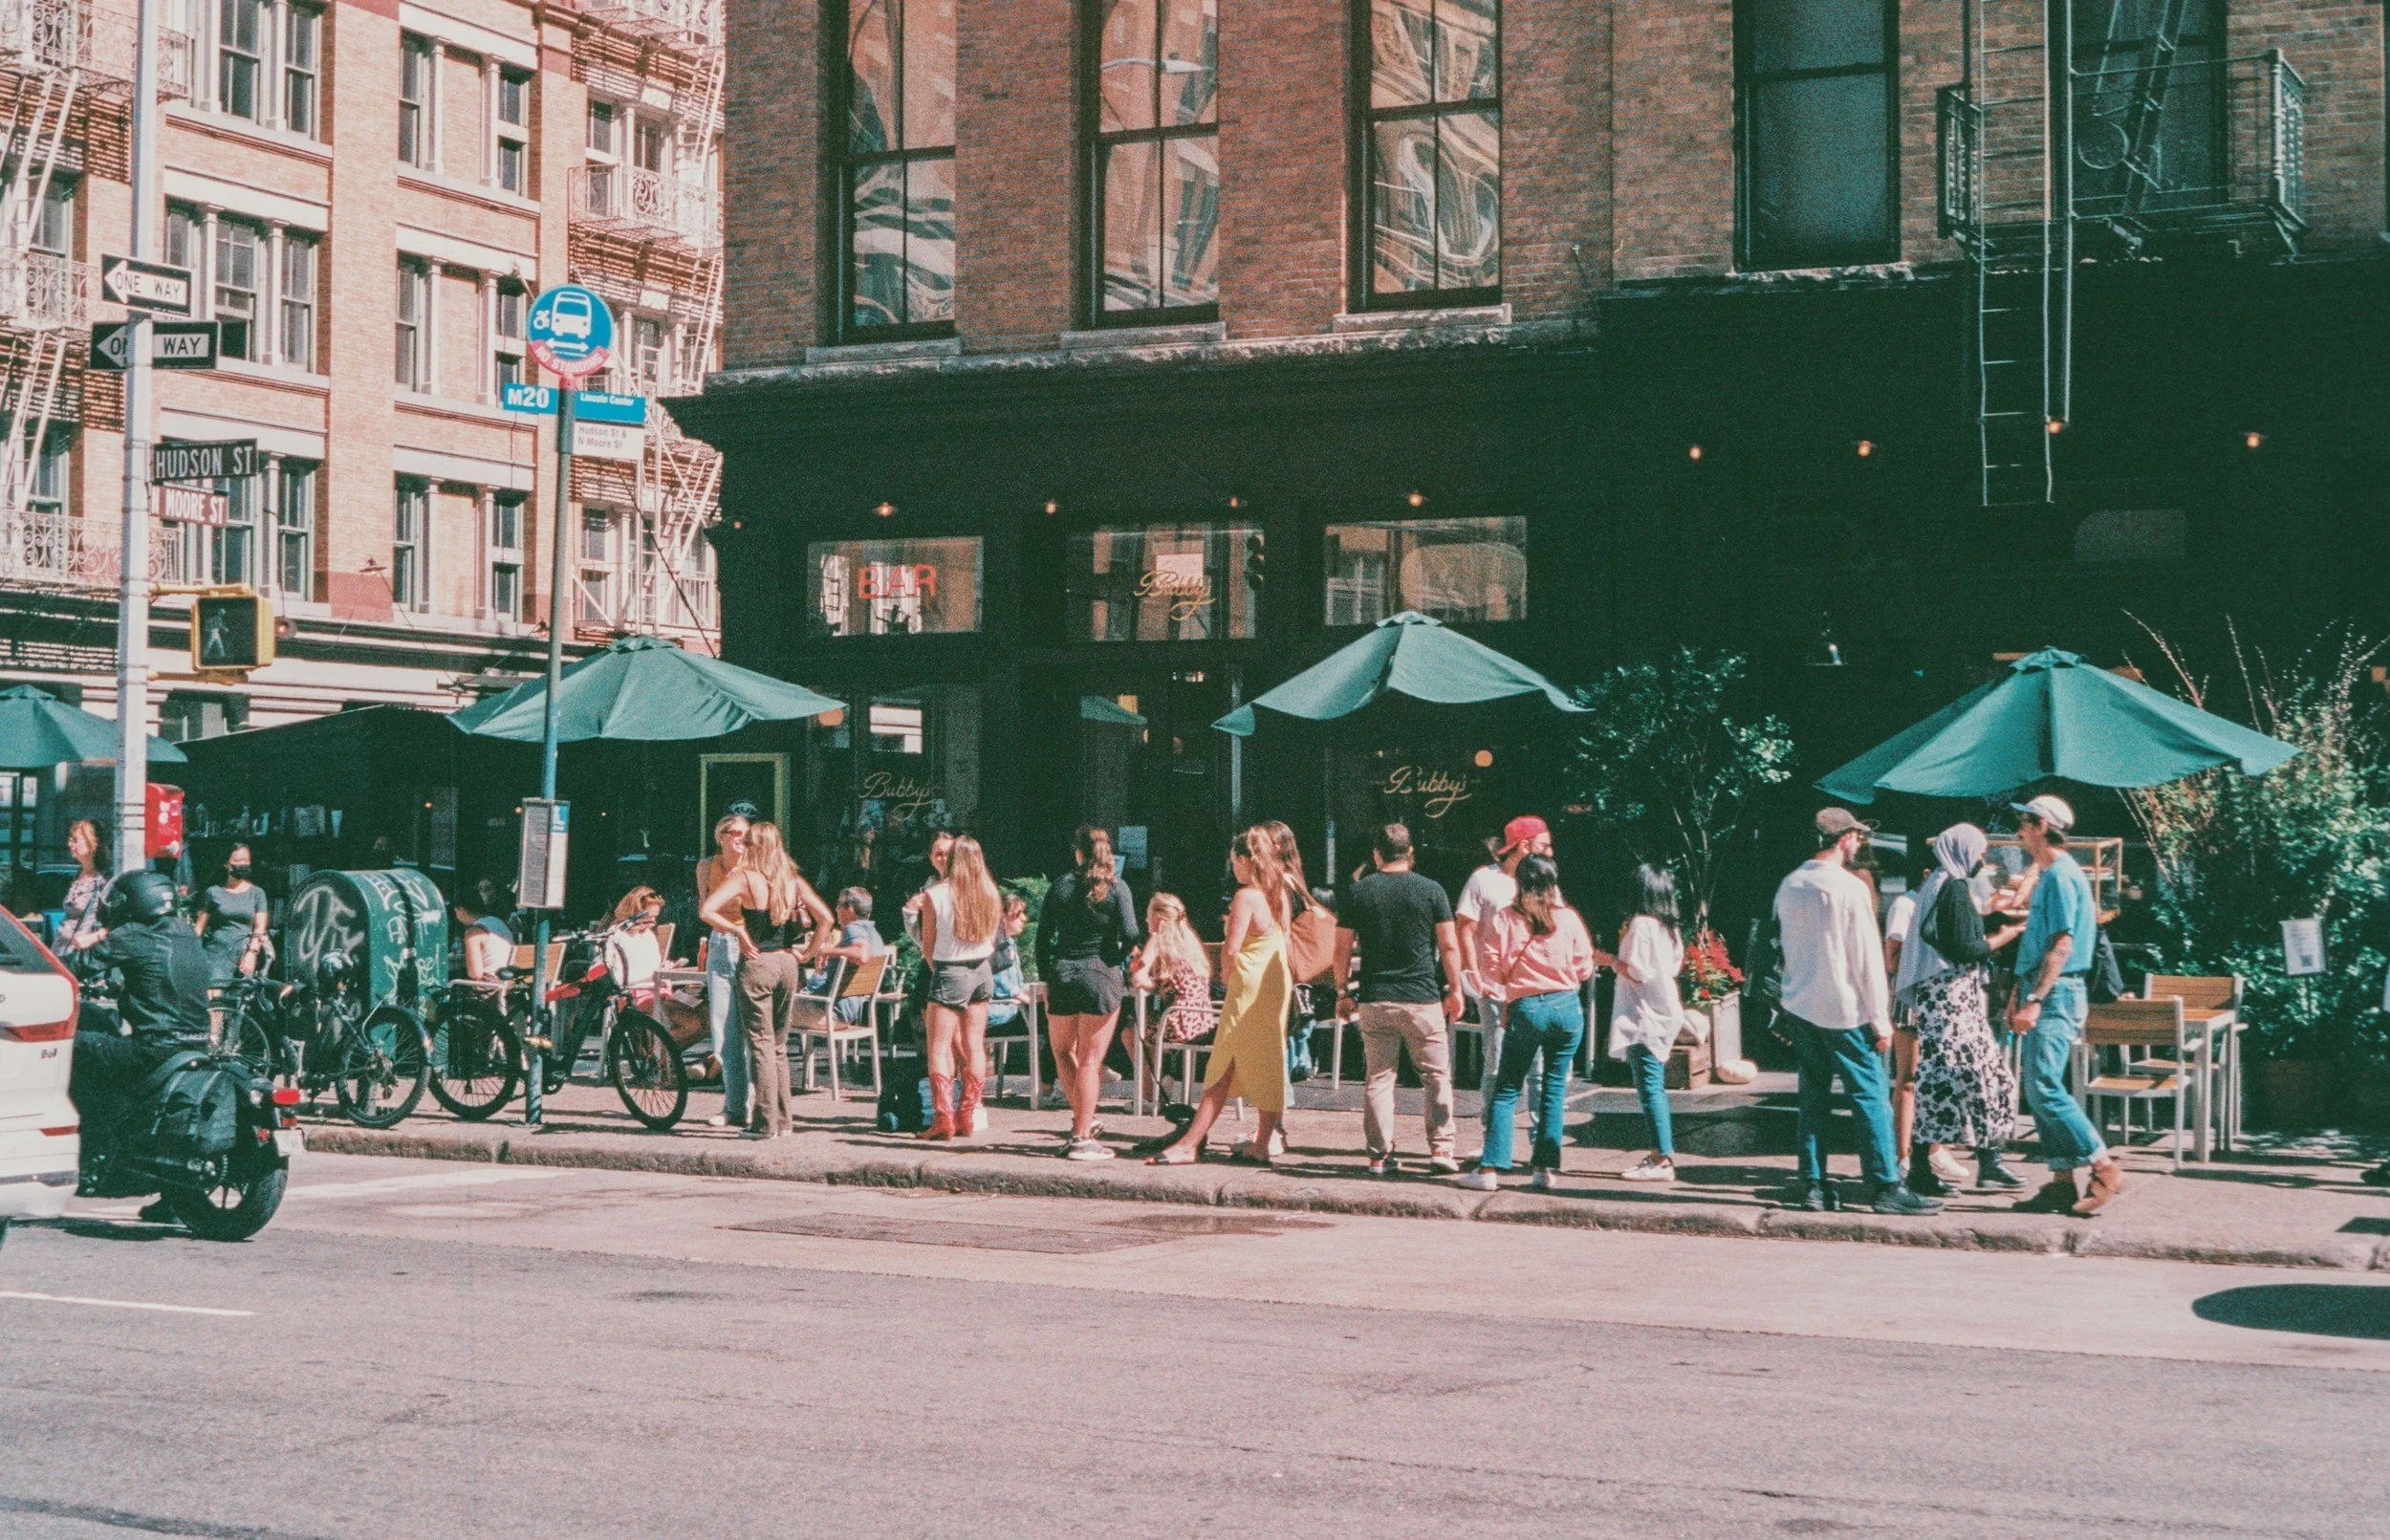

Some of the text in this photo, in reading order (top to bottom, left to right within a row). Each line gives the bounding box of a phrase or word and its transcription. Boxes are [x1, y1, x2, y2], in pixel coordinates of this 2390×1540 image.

[115, 271, 180, 301] ONE WAY
[163, 336, 201, 355] WAY
[535, 346, 552, 363] NO
[508, 386, 550, 408] M20
[580, 392, 635, 406] Lincoln Center
[578, 426, 608, 436] Hudson
[611, 428, 619, 437] St
[586, 438, 612, 447] Moore
[614, 441, 622, 449] St
[155, 445, 253, 478] HUDSON ST
[150, 487, 226, 525] N MOORE ST
[858, 563, 937, 599] BAR
